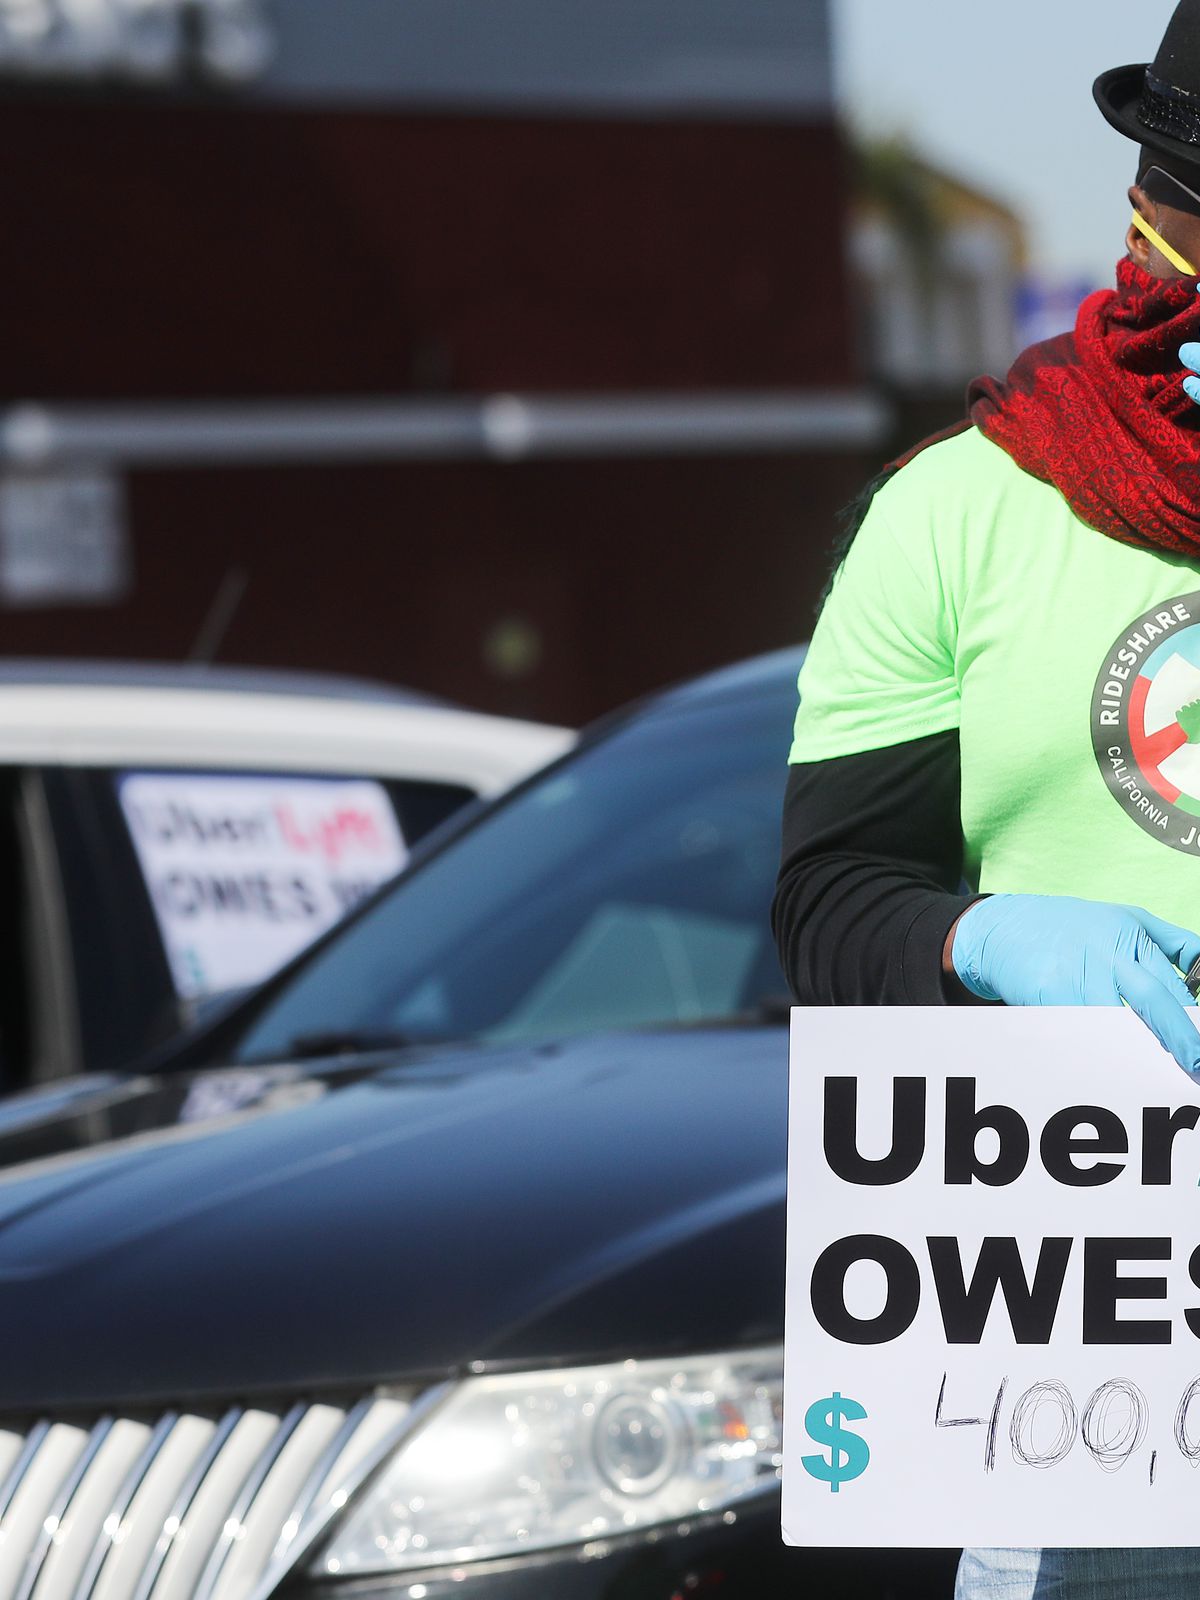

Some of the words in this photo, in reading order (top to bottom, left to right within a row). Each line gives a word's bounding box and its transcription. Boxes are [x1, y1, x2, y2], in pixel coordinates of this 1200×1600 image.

[1099, 603, 1191, 725] RIDESHARE
[1106, 745, 1170, 830] CALIFORNIA
[800, 1390, 871, 1493] $
